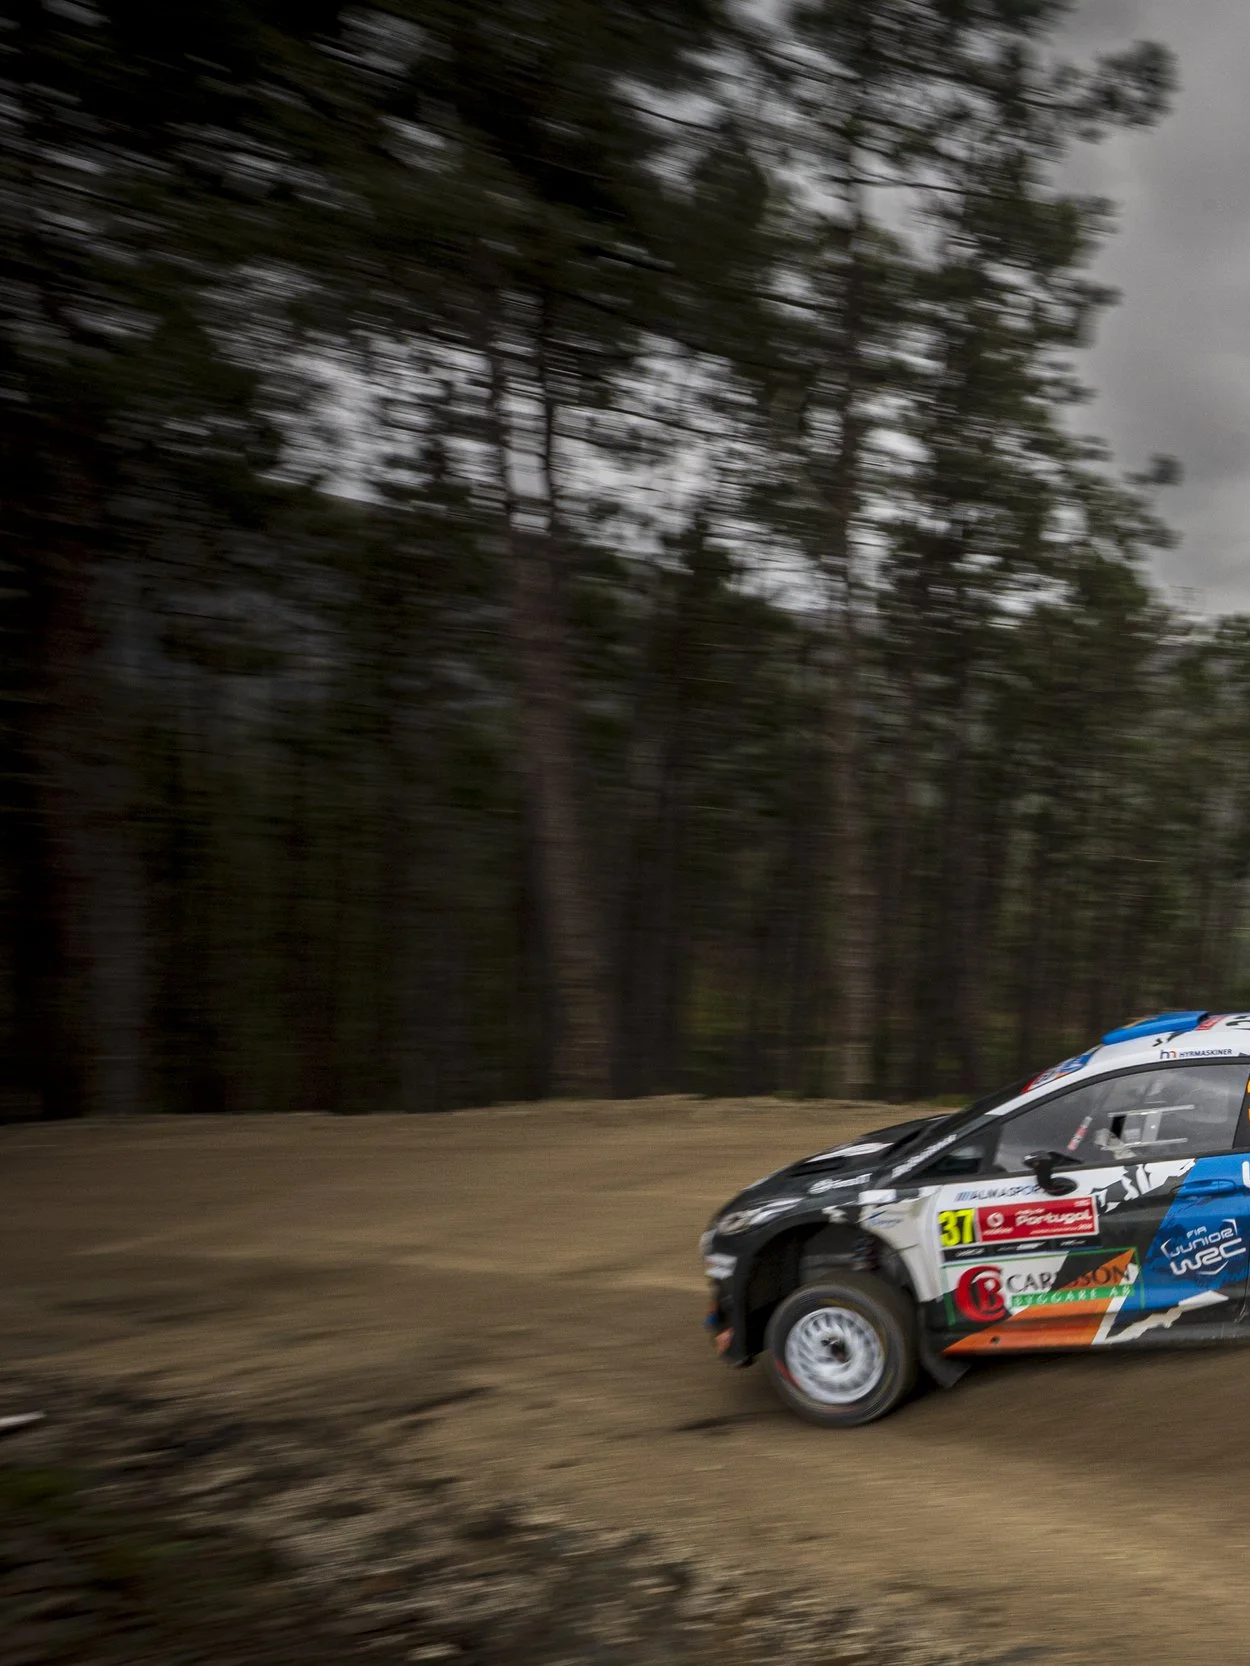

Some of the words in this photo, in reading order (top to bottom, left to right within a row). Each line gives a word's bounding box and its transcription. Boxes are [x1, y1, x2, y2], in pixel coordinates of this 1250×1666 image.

[1180, 1049, 1233, 1058] HYRMASKINER
[937, 1208, 976, 1247] 37
[1015, 1209, 1093, 1228] Portugal
[1169, 1227, 1234, 1257] JUNIOR
[1186, 1226, 1207, 1238] FIA
[1170, 1238, 1246, 1275] WRC
